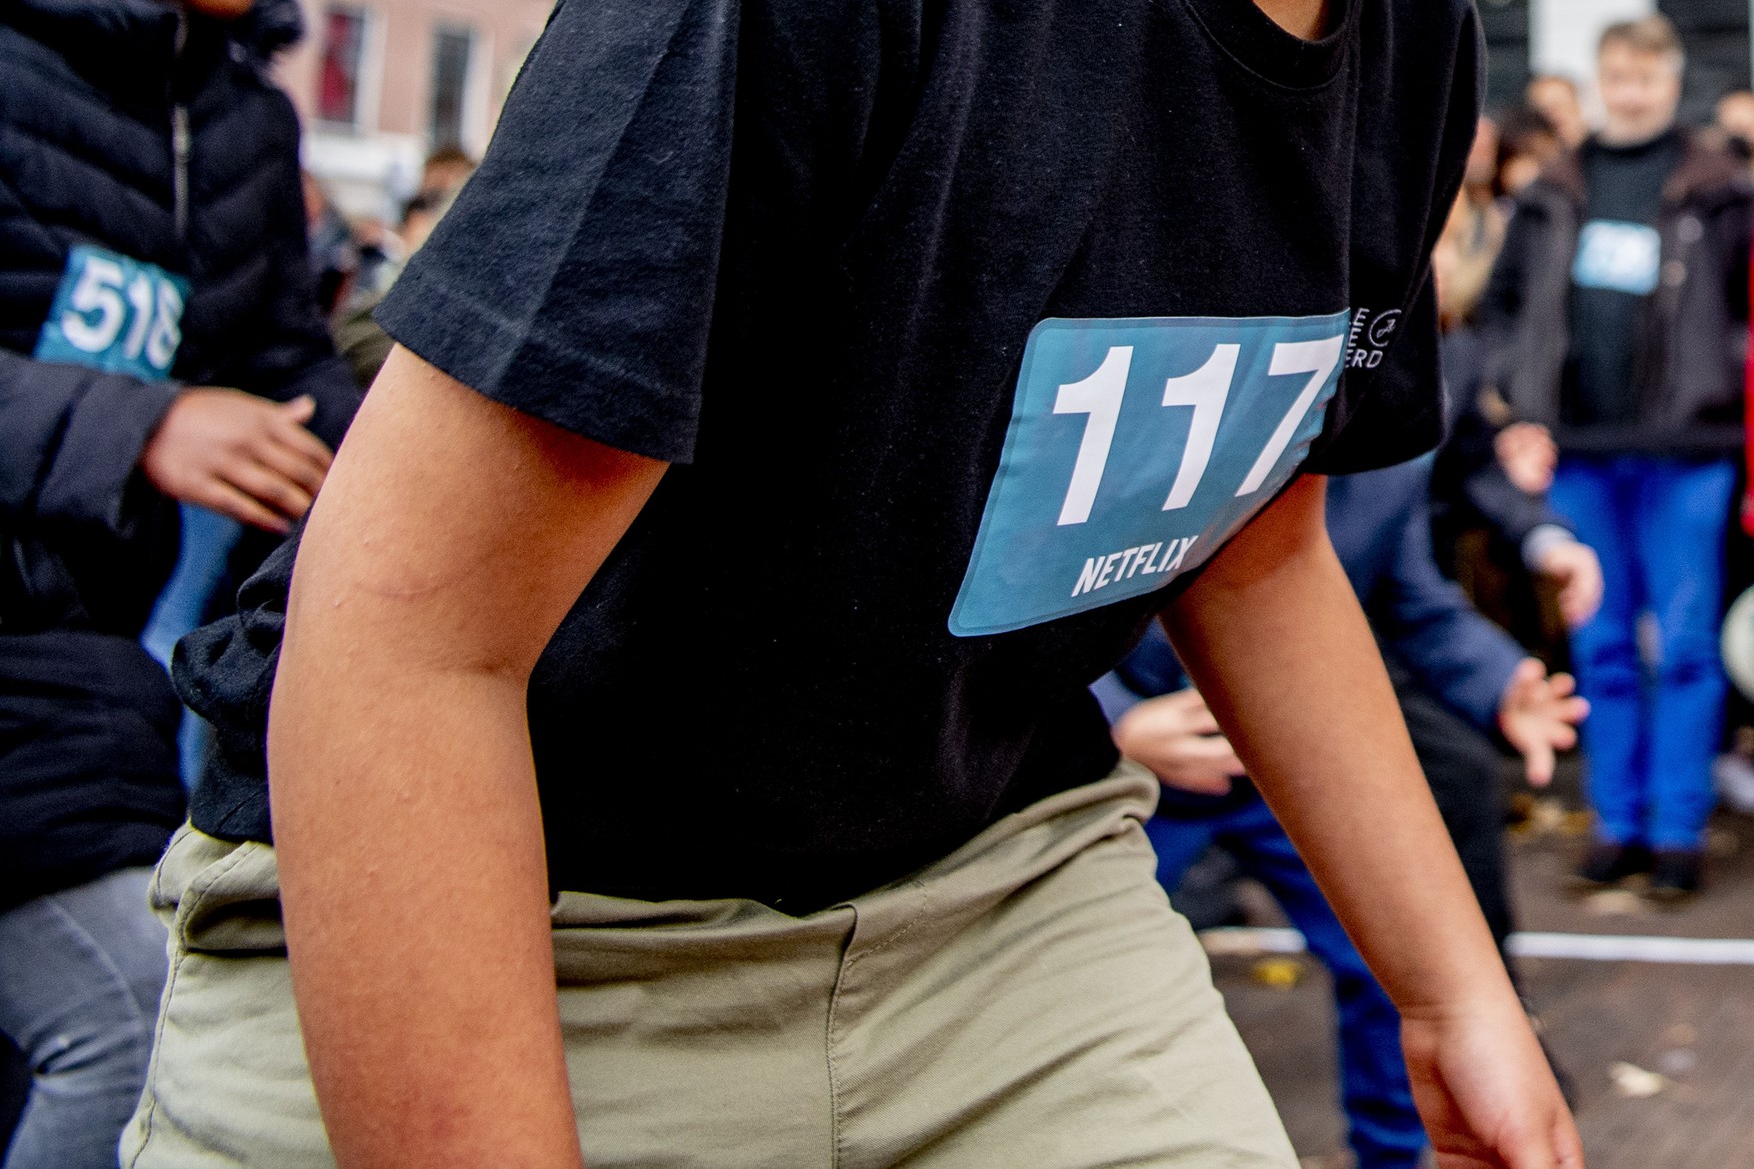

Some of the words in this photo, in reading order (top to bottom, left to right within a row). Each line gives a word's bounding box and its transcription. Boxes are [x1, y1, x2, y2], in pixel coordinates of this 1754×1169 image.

[61, 255, 183, 369] 518
[1053, 334, 1344, 526] 117
[1071, 535, 1199, 597] NETFLIX
